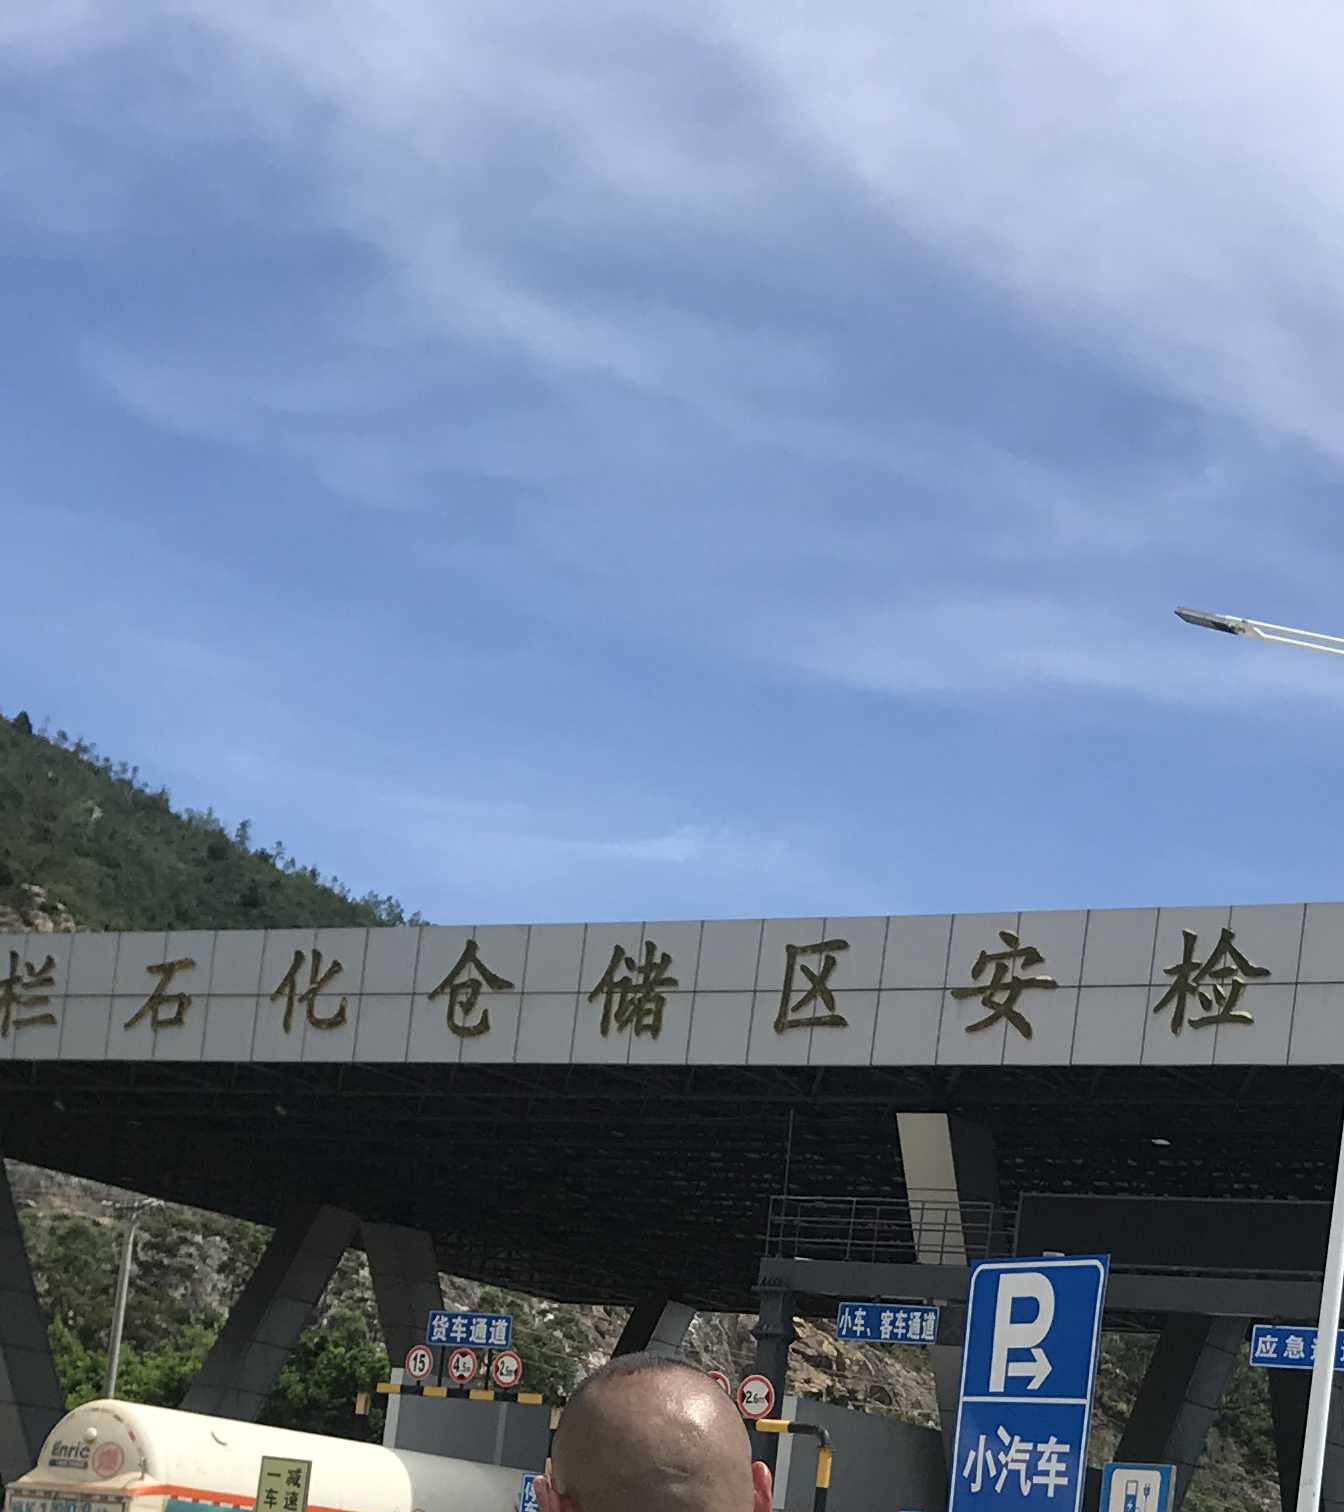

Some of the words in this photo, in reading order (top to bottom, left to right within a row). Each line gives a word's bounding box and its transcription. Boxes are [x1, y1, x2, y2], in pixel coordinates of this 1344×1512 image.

[431, 1314, 509, 1345] 货车通道
[839, 1307, 936, 1340] 小车、客车通道
[989, 1272, 1056, 1392] P
[412, 1353, 426, 1372] 15
[51, 1441, 91, 1460] Enric
[962, 1425, 1071, 1498] 小汽车
